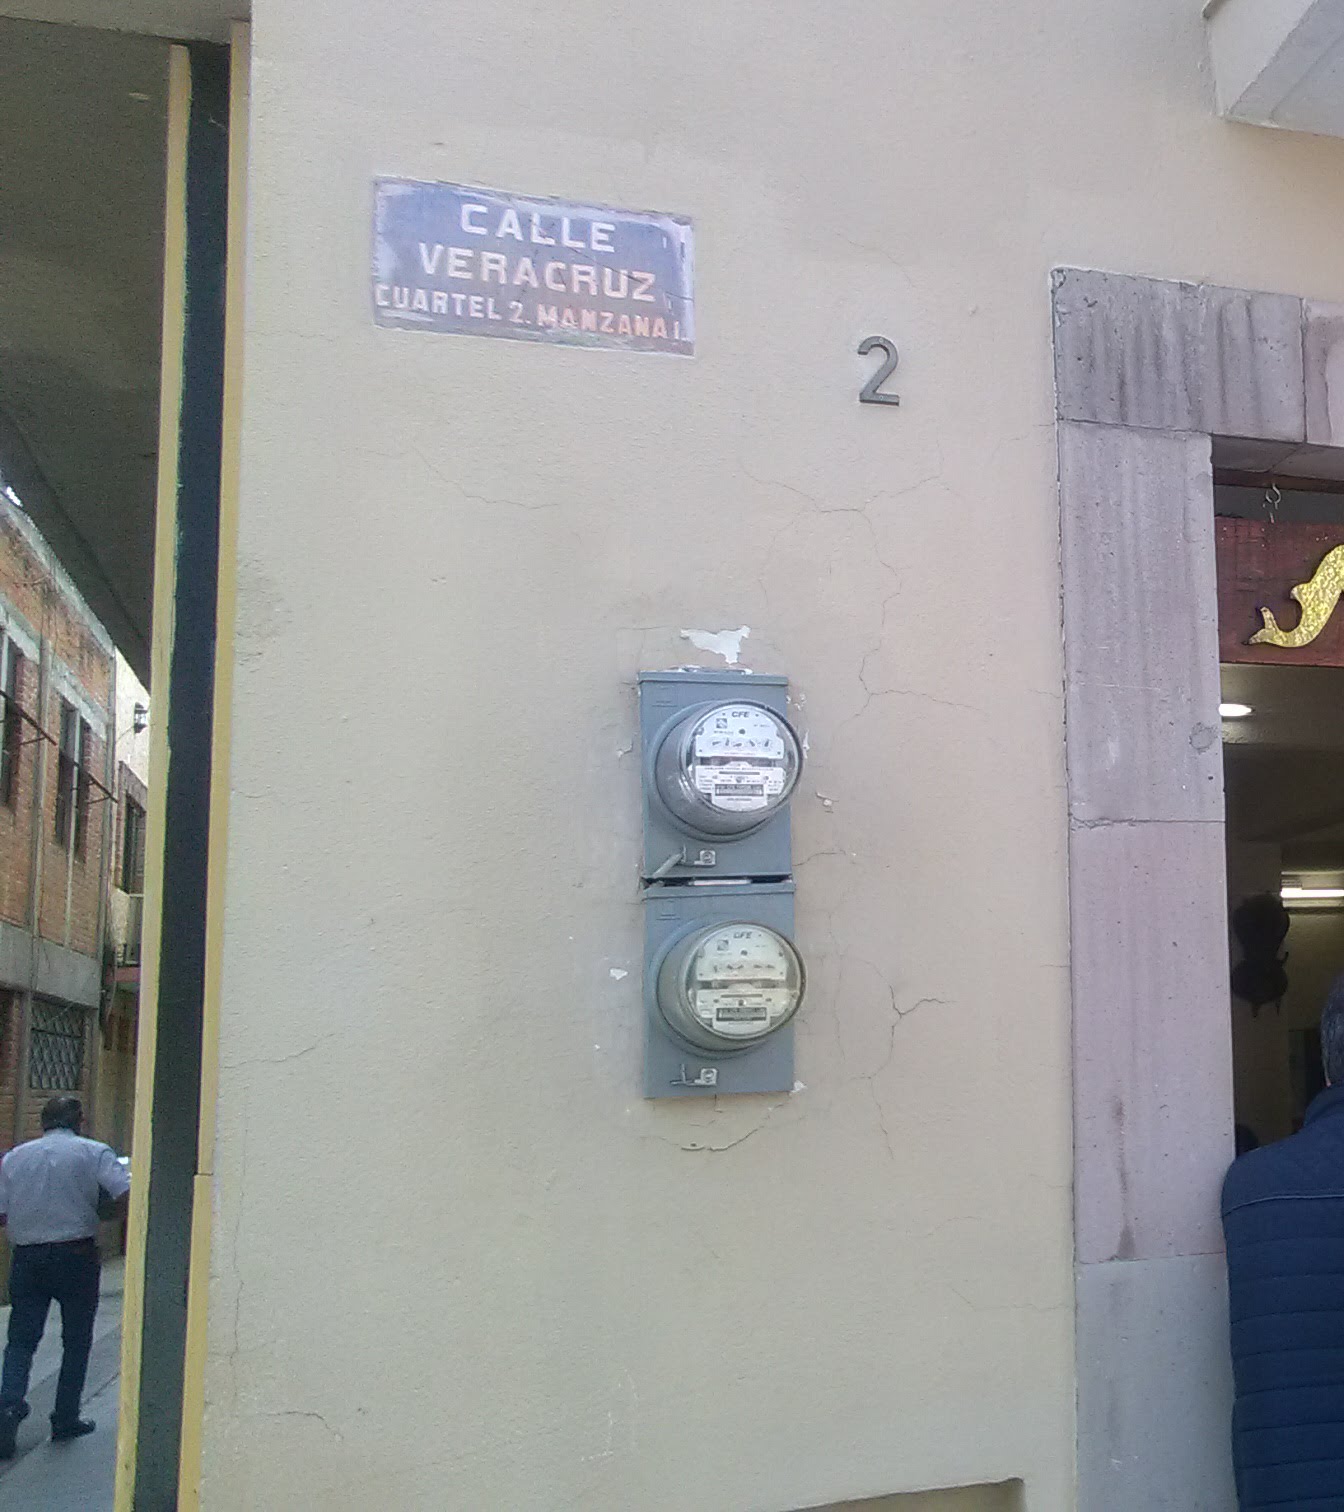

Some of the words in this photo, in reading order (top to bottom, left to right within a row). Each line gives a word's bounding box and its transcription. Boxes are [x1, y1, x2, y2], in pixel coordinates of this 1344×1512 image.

[460, 203, 616, 253] CALLE
[418, 242, 656, 302] VERACRUZ
[375, 285, 502, 320] CUARTEL
[536, 303, 669, 338] MANZANA
[857, 335, 900, 407] 2
